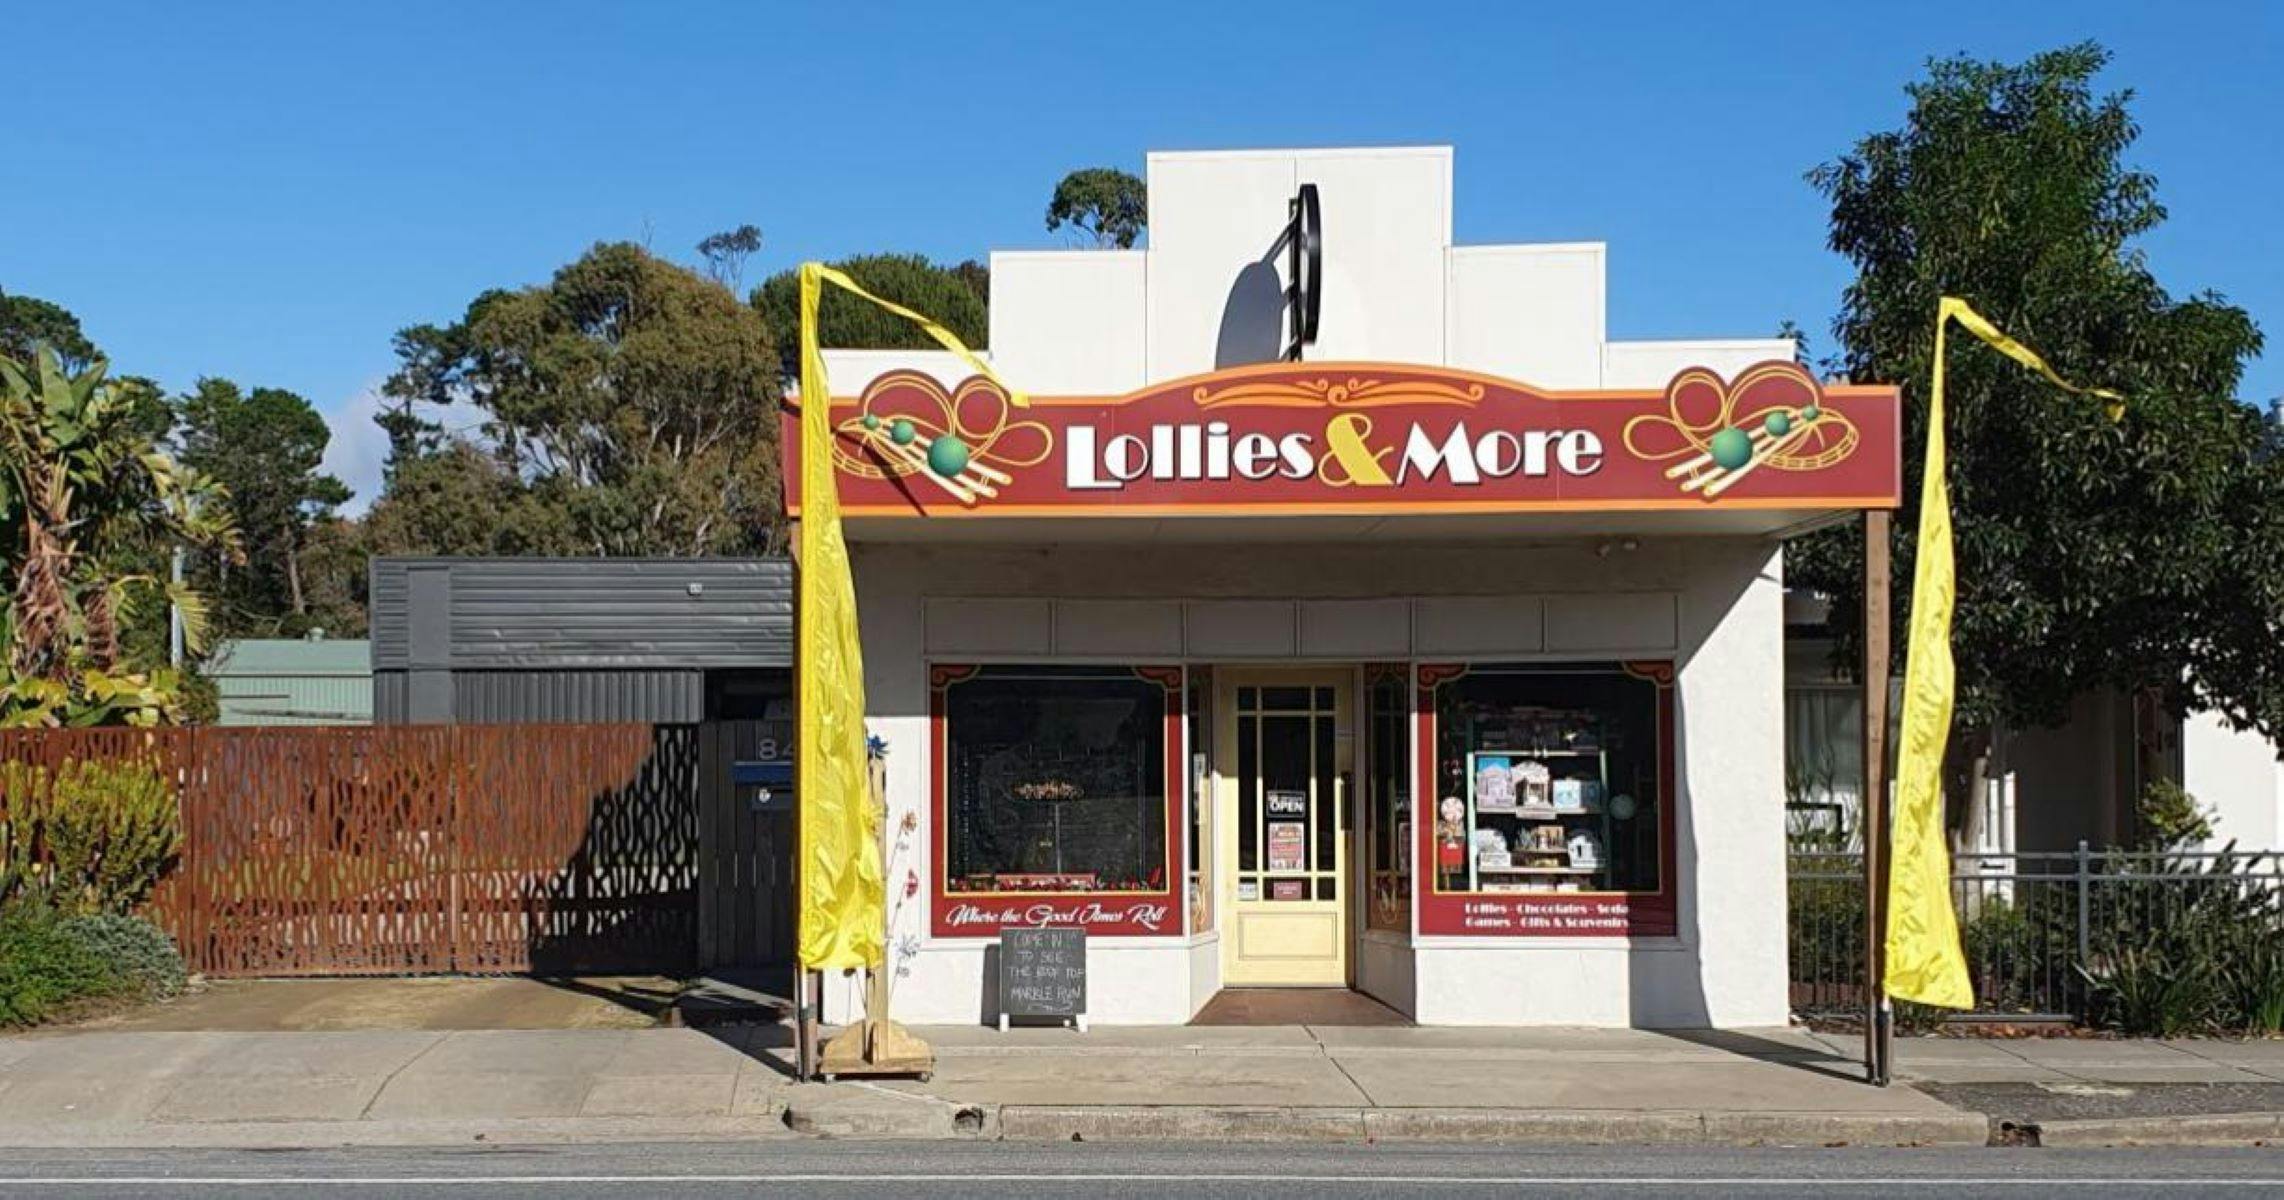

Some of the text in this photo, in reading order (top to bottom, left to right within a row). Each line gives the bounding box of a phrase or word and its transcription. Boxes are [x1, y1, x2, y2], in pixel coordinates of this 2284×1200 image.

[1066, 413, 1603, 489] Lollies & More
[1269, 800, 1304, 813] OPEN
[1465, 903, 1507, 914] Lollies
[1516, 903, 1587, 914] Chocolates
[1597, 903, 1629, 914] Soda
[946, 902, 1168, 931] Where the Good Times Roll
[1465, 917, 1511, 928] Games
[1520, 917, 1550, 928] Gifts
[1565, 917, 1629, 928] Souvenirs
